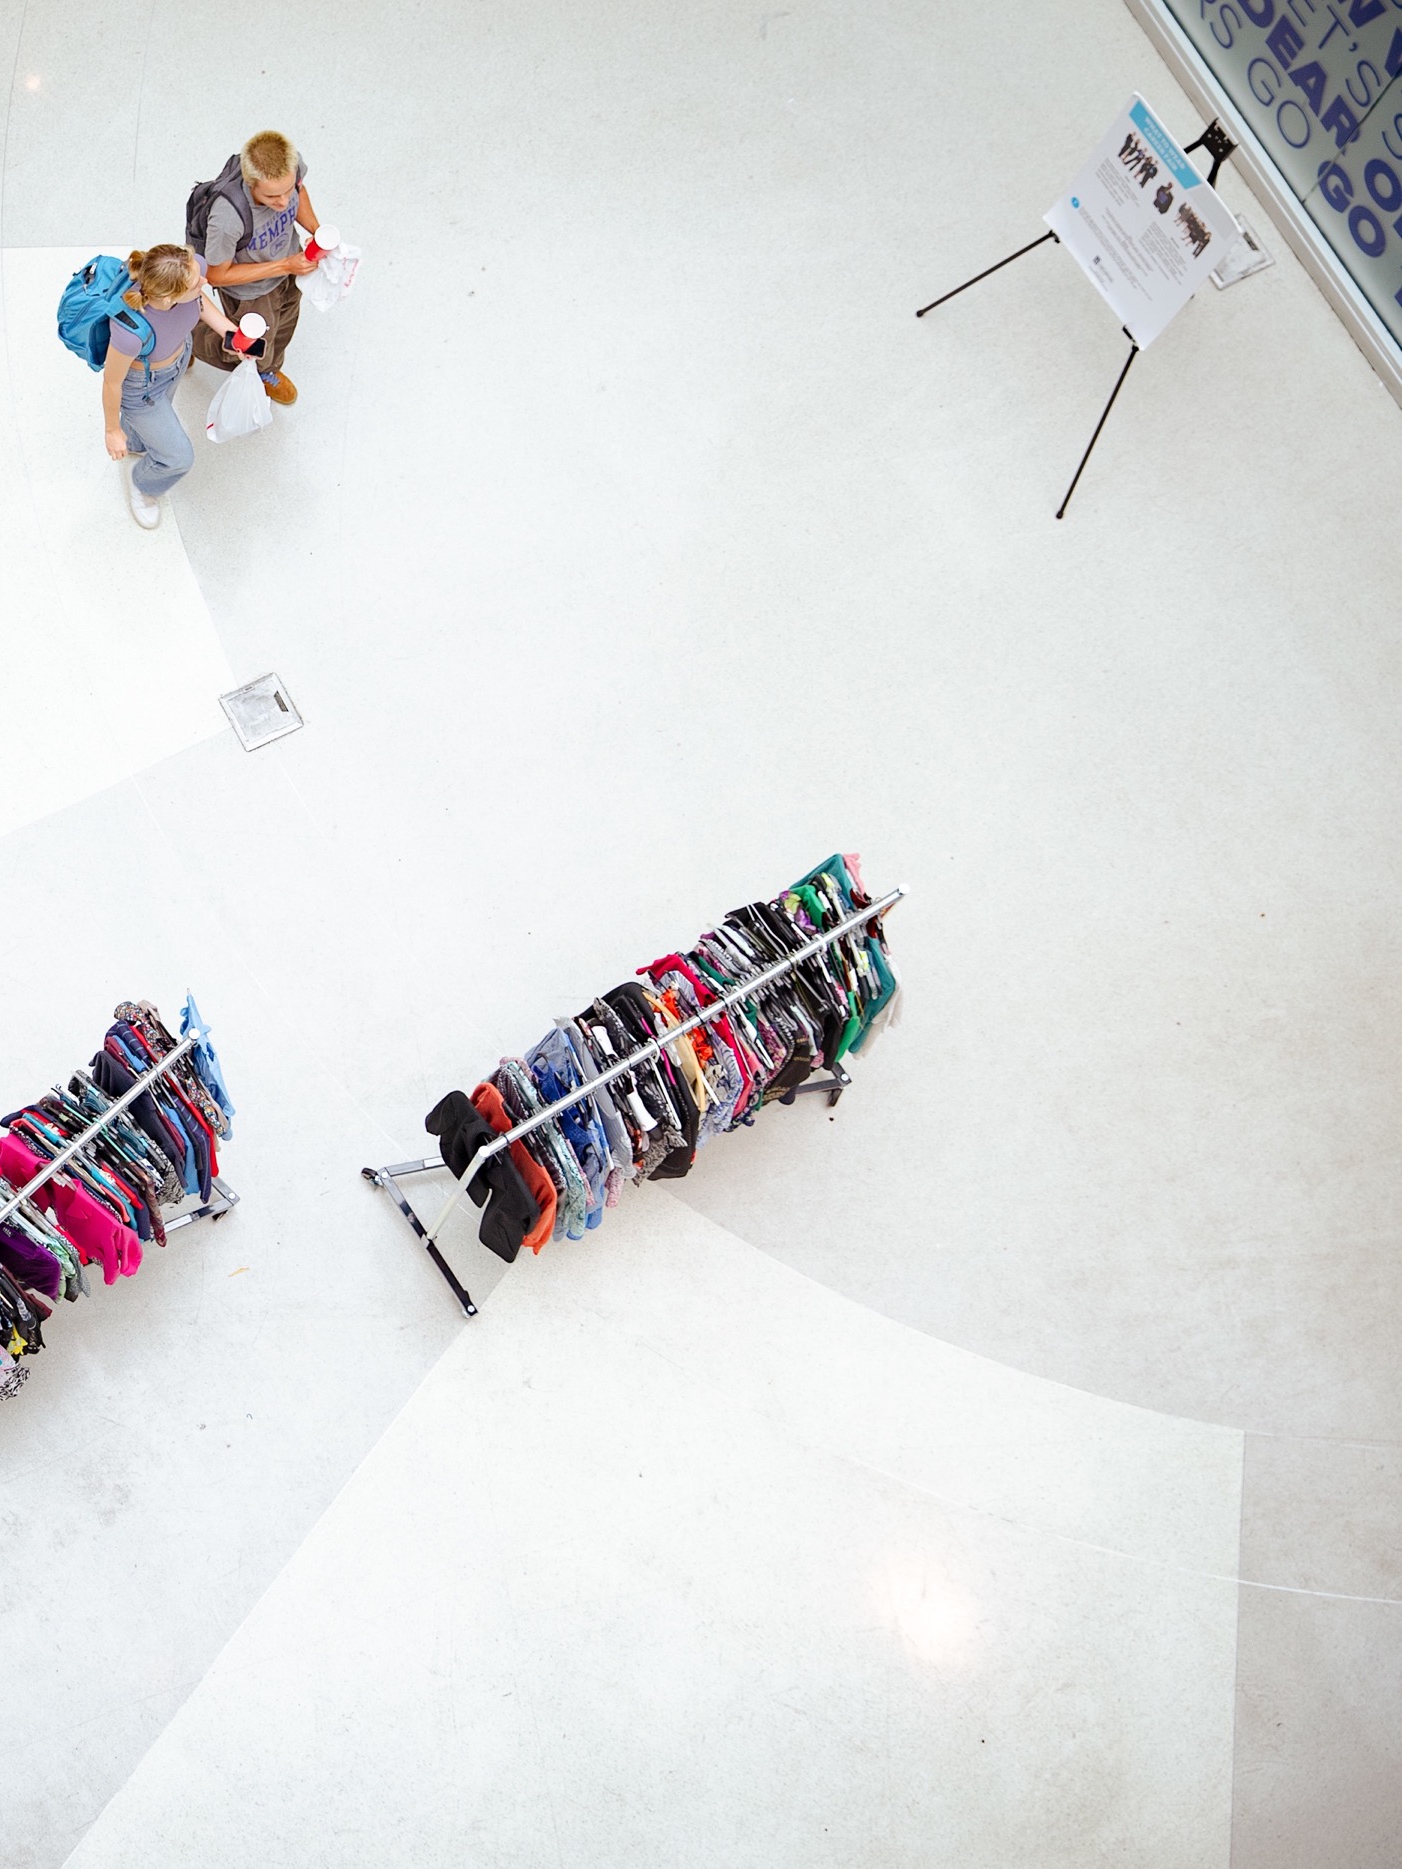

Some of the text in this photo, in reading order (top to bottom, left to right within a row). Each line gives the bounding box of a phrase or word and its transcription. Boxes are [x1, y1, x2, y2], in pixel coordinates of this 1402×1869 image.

[1246, 57, 1311, 149] GO
[1317, 159, 1387, 258] GO
[246, 204, 297, 251] MEMPH
